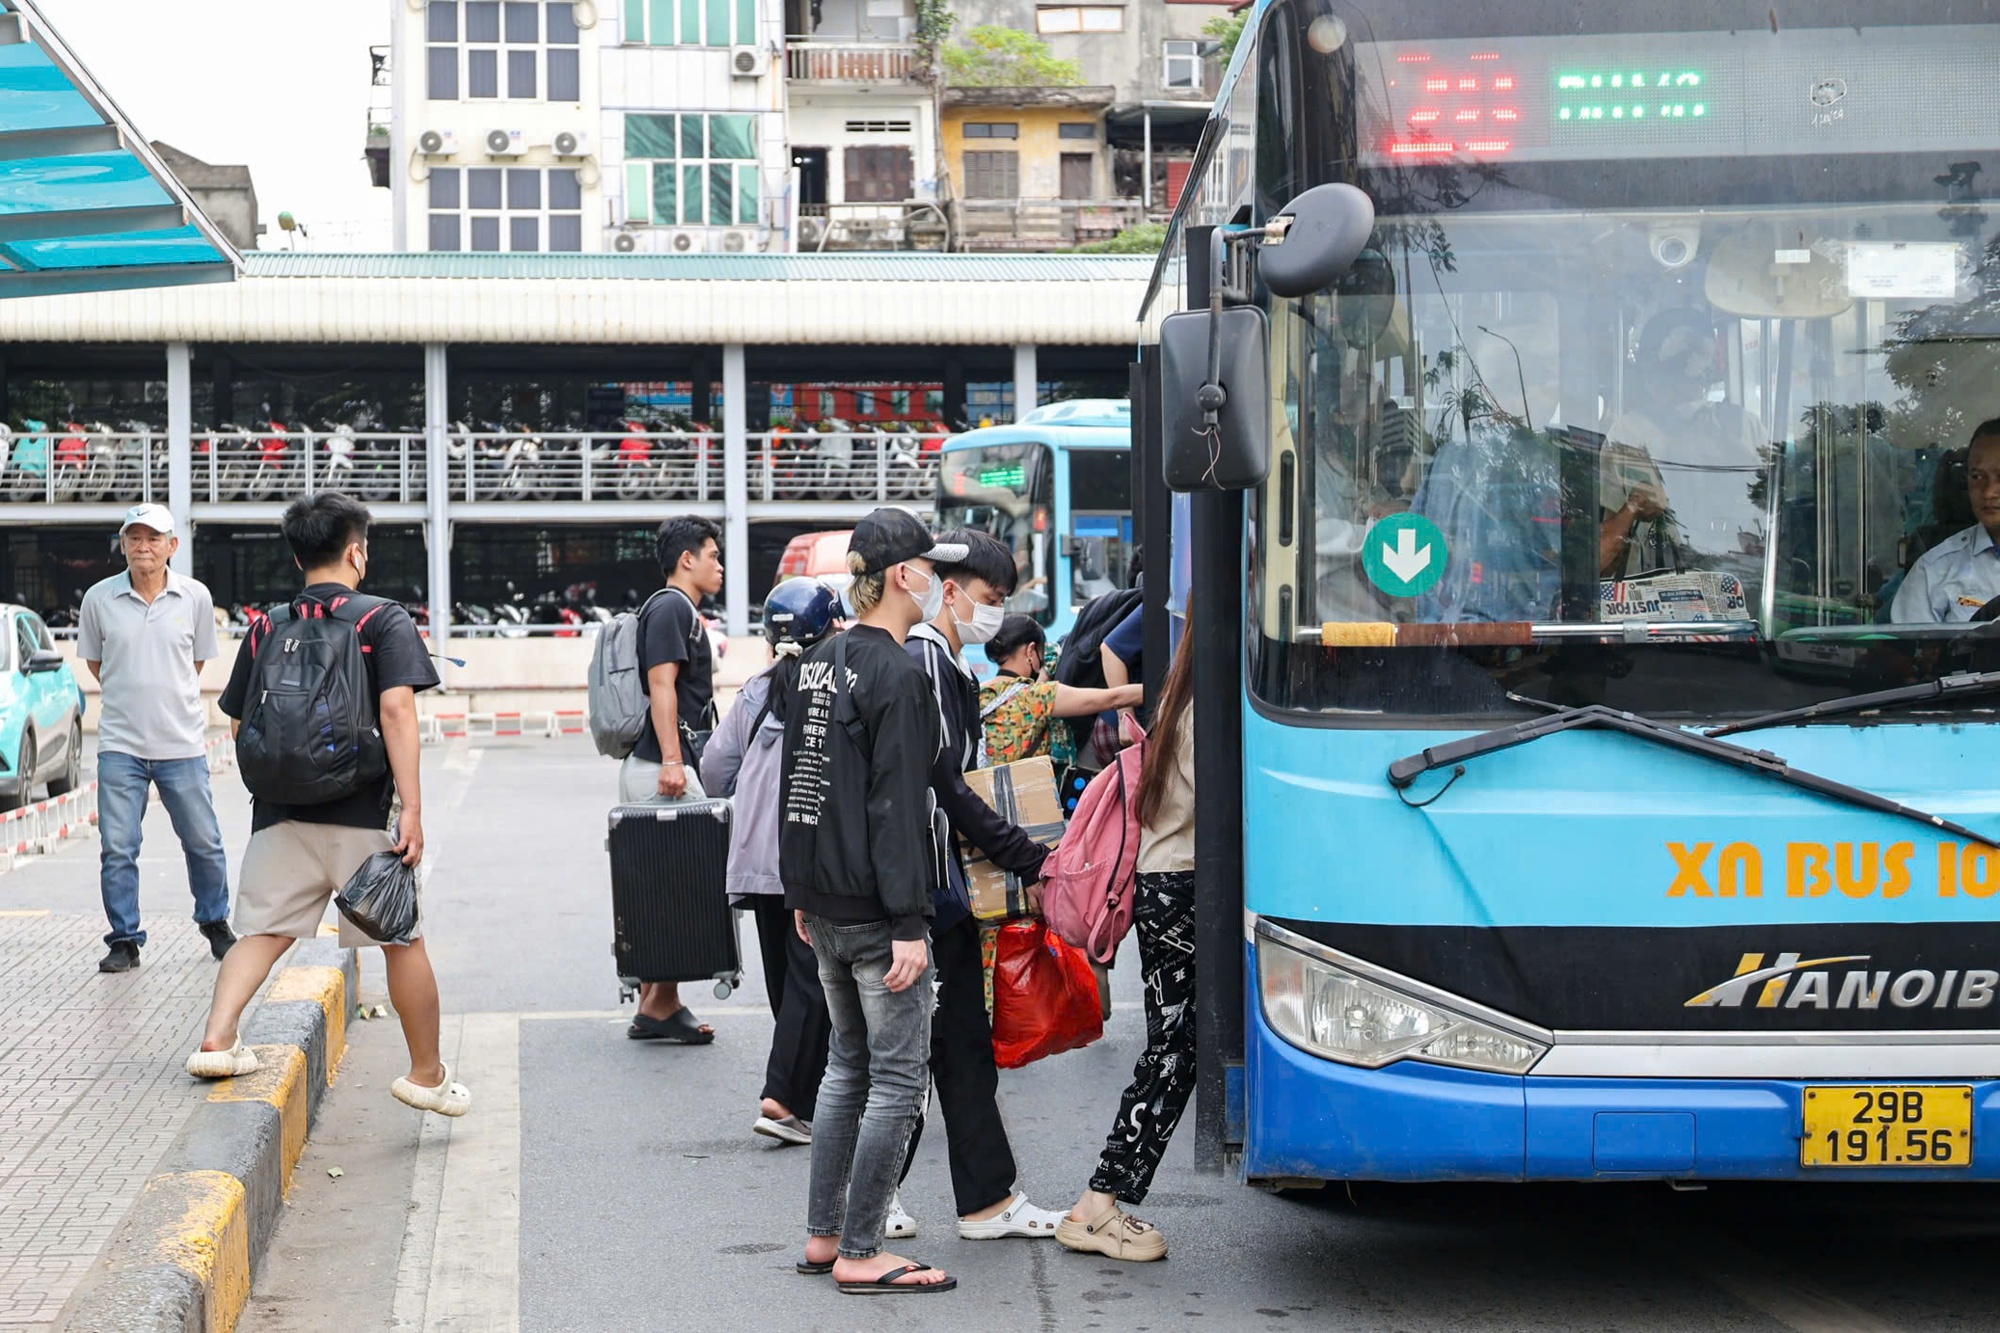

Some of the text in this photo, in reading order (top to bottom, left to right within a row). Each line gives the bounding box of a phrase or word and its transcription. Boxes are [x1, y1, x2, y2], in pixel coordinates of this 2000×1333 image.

[1606, 599, 1660, 616] JUST FOR
[1786, 841, 1915, 898] BUS
[1853, 1092, 1924, 1124] 29B
[1826, 1129, 1953, 1162] 191.56
